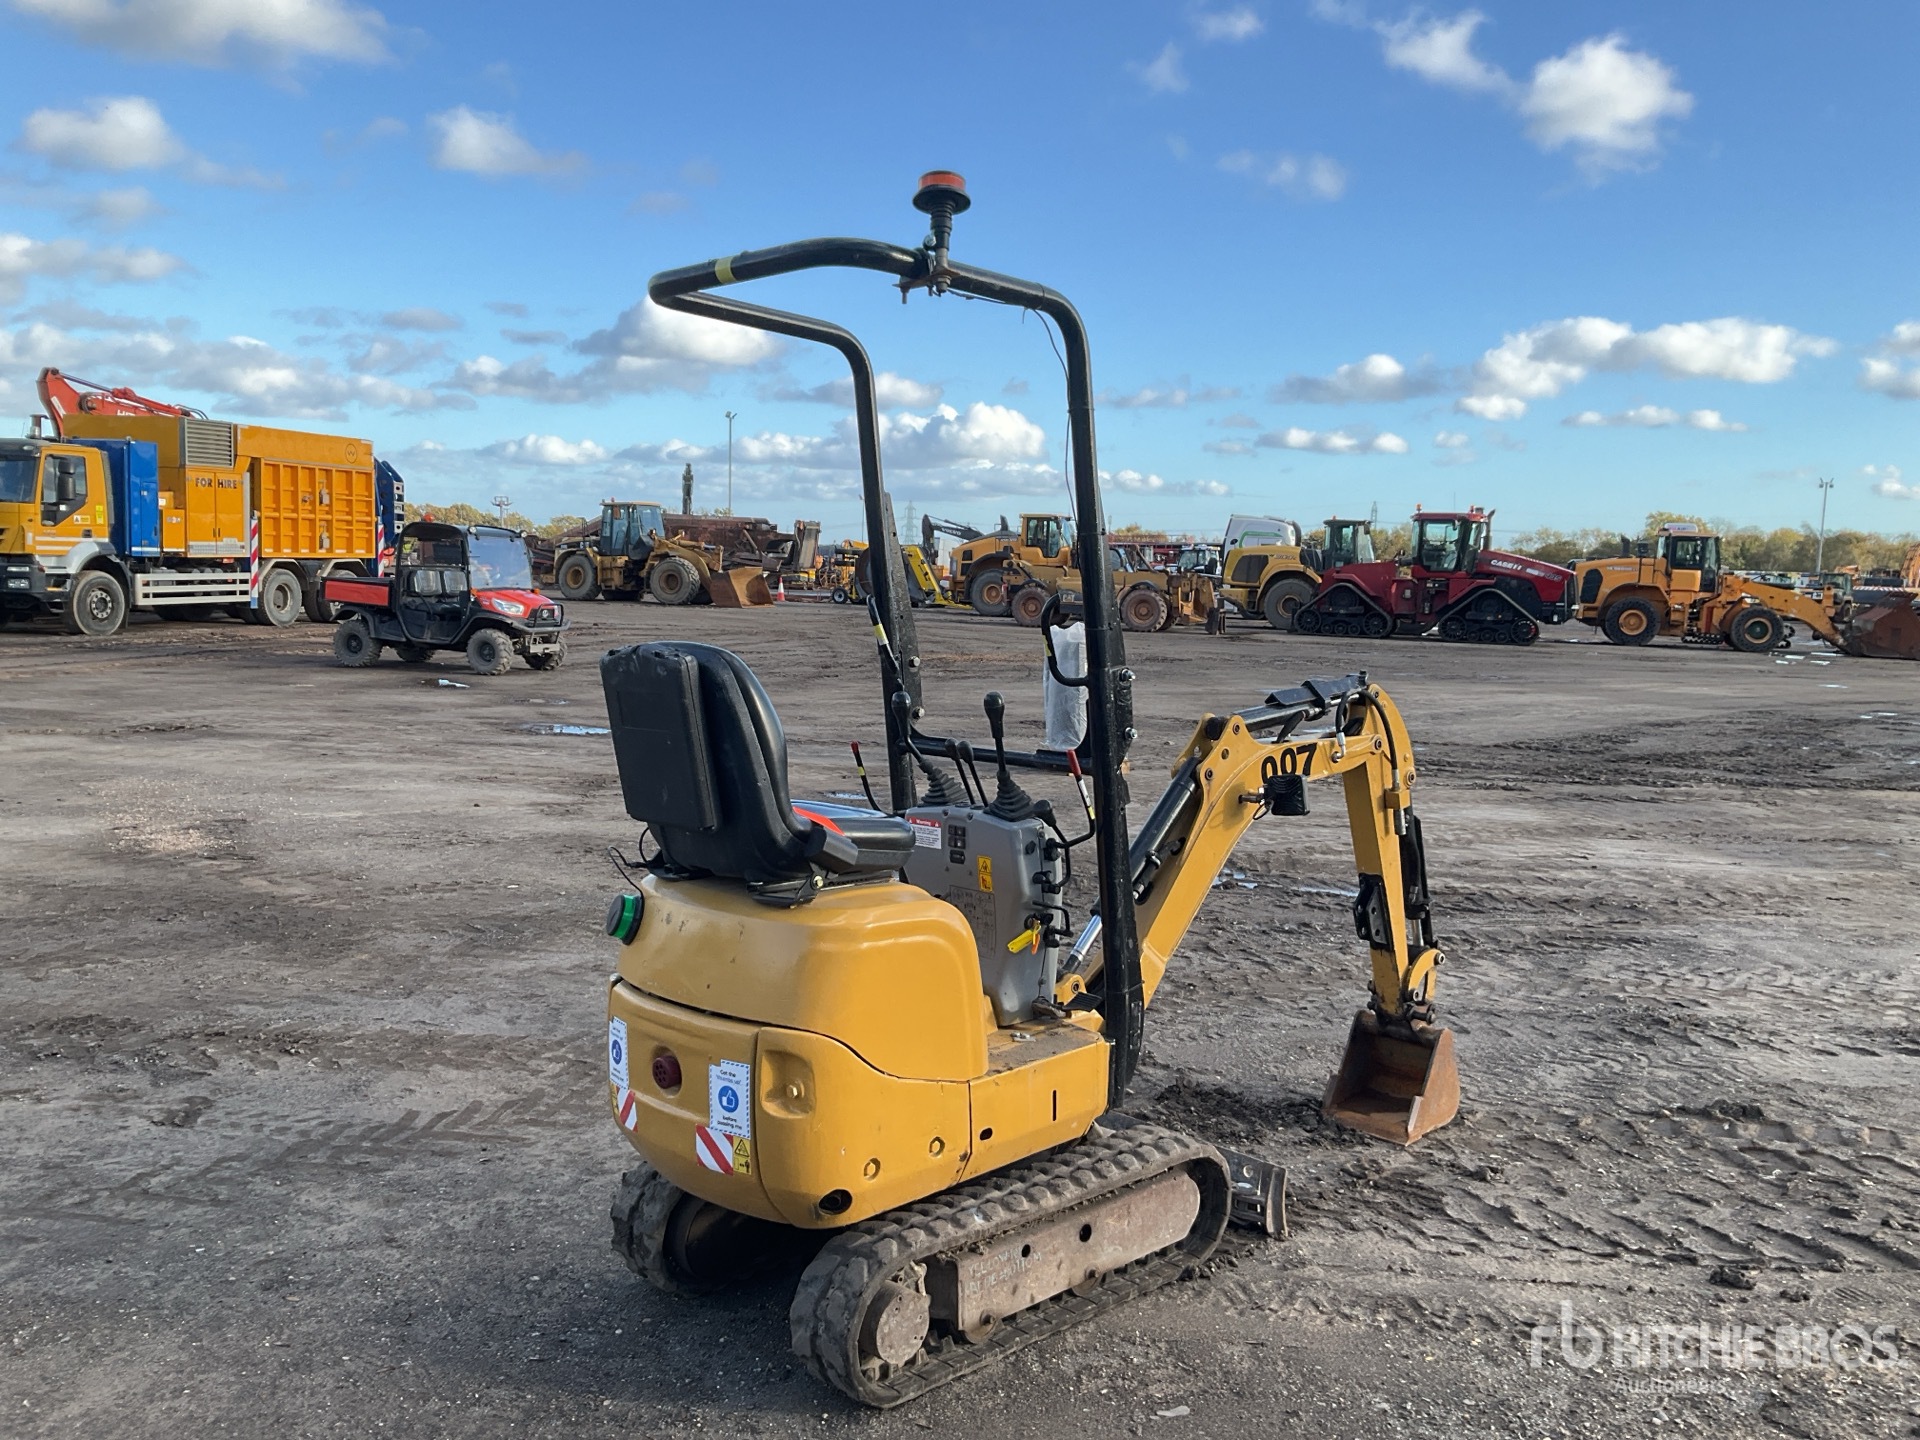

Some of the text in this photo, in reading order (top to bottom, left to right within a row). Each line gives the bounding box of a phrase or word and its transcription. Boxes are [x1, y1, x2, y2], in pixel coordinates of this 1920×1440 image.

[195, 478, 238, 489] FOR HIRE
[941, 527, 962, 536] VOLVO
[1261, 743, 1317, 784] 007
